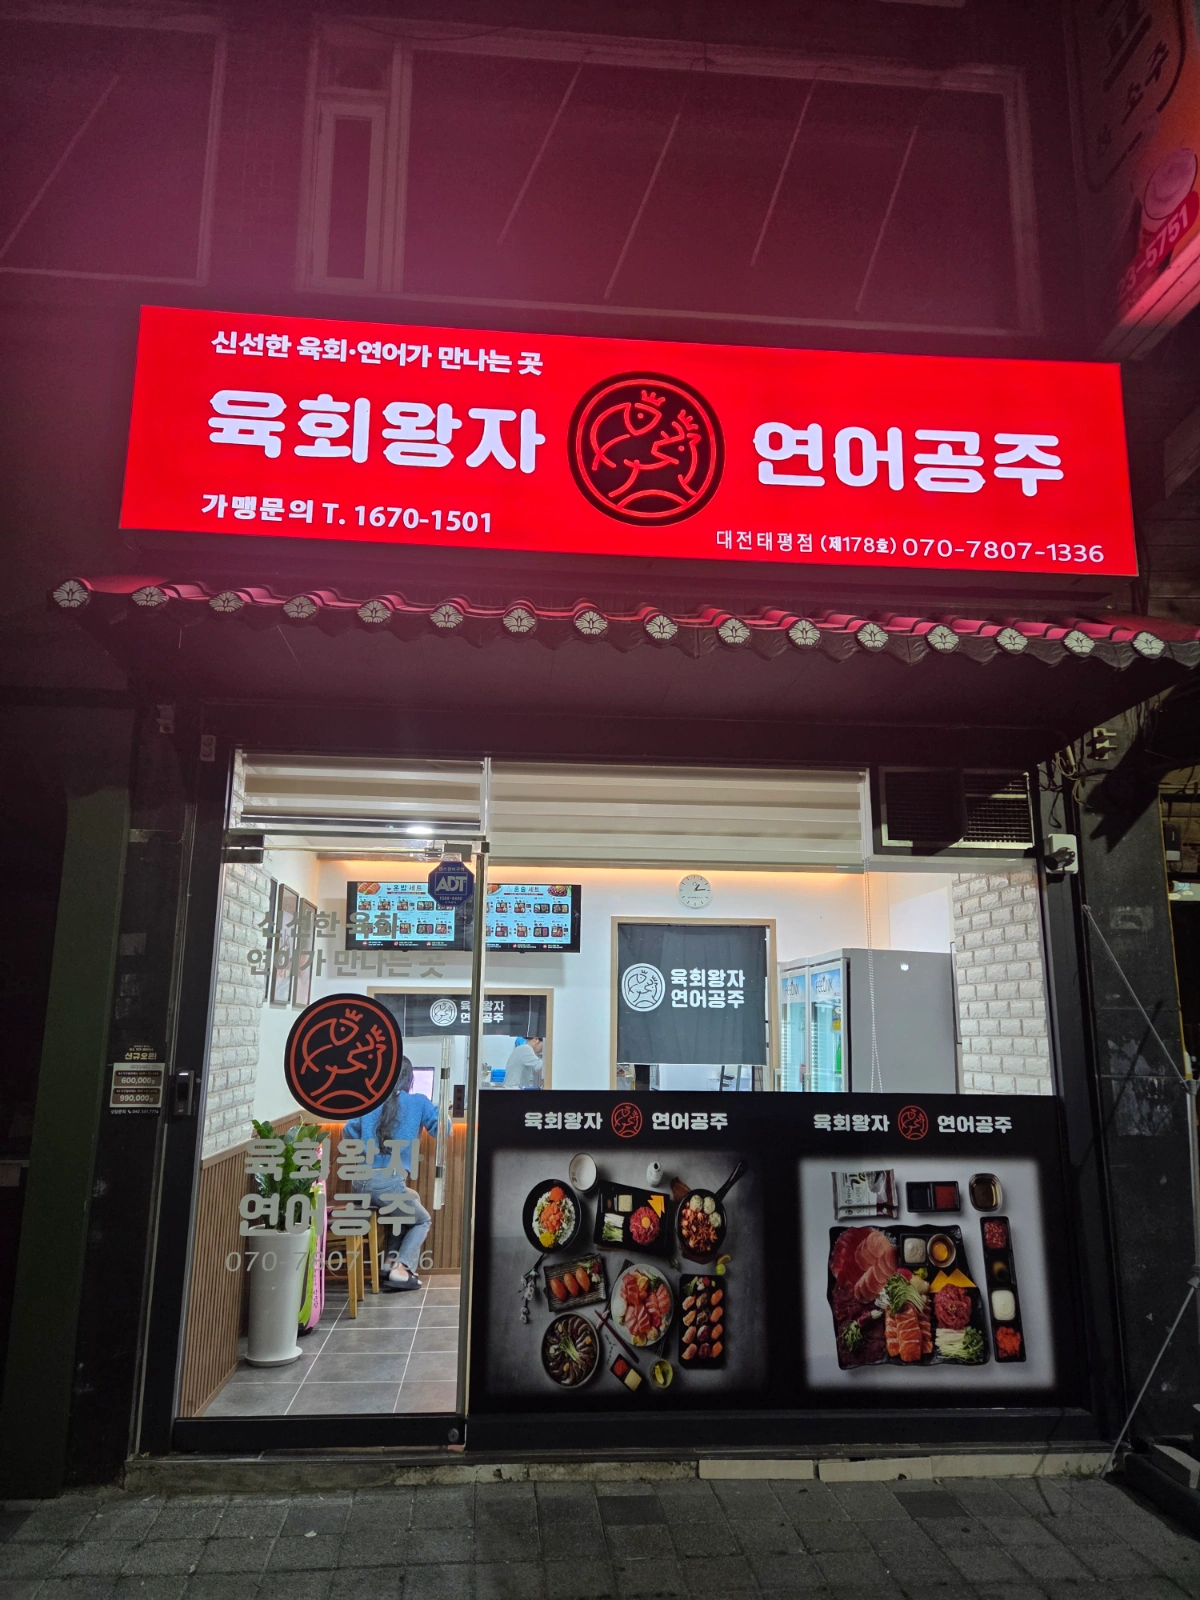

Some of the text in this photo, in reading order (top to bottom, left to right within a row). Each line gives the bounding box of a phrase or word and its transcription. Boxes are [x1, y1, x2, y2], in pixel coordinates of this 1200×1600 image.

[211, 331, 544, 376] 신선한 육회·연어가 만나는 곳
[208, 389, 546, 474] 육회왕자
[752, 421, 1064, 497] 연어공주
[201, 493, 492, 533] 가맹문의 T. 1670-1501
[716, 529, 1105, 563] 대전태평점 (제178호) 070-7807-1336
[435, 876, 468, 892] ADT
[257, 910, 398, 939] 신선한 육회
[246, 949, 446, 978] 연어가 만나는 곳
[670, 966, 746, 989] 육회왕자
[460, 1000, 505, 1012] 육왕자
[670, 989, 745, 1010] 연어공주
[460, 1012, 504, 1024] 연공주
[524, 1111, 728, 1131] 육회왕자 연어공주
[813, 1113, 1012, 1134] 육회왕자 연어공주
[244, 1137, 424, 1182] 육회왕자
[239, 1192, 416, 1237] 연어공주
